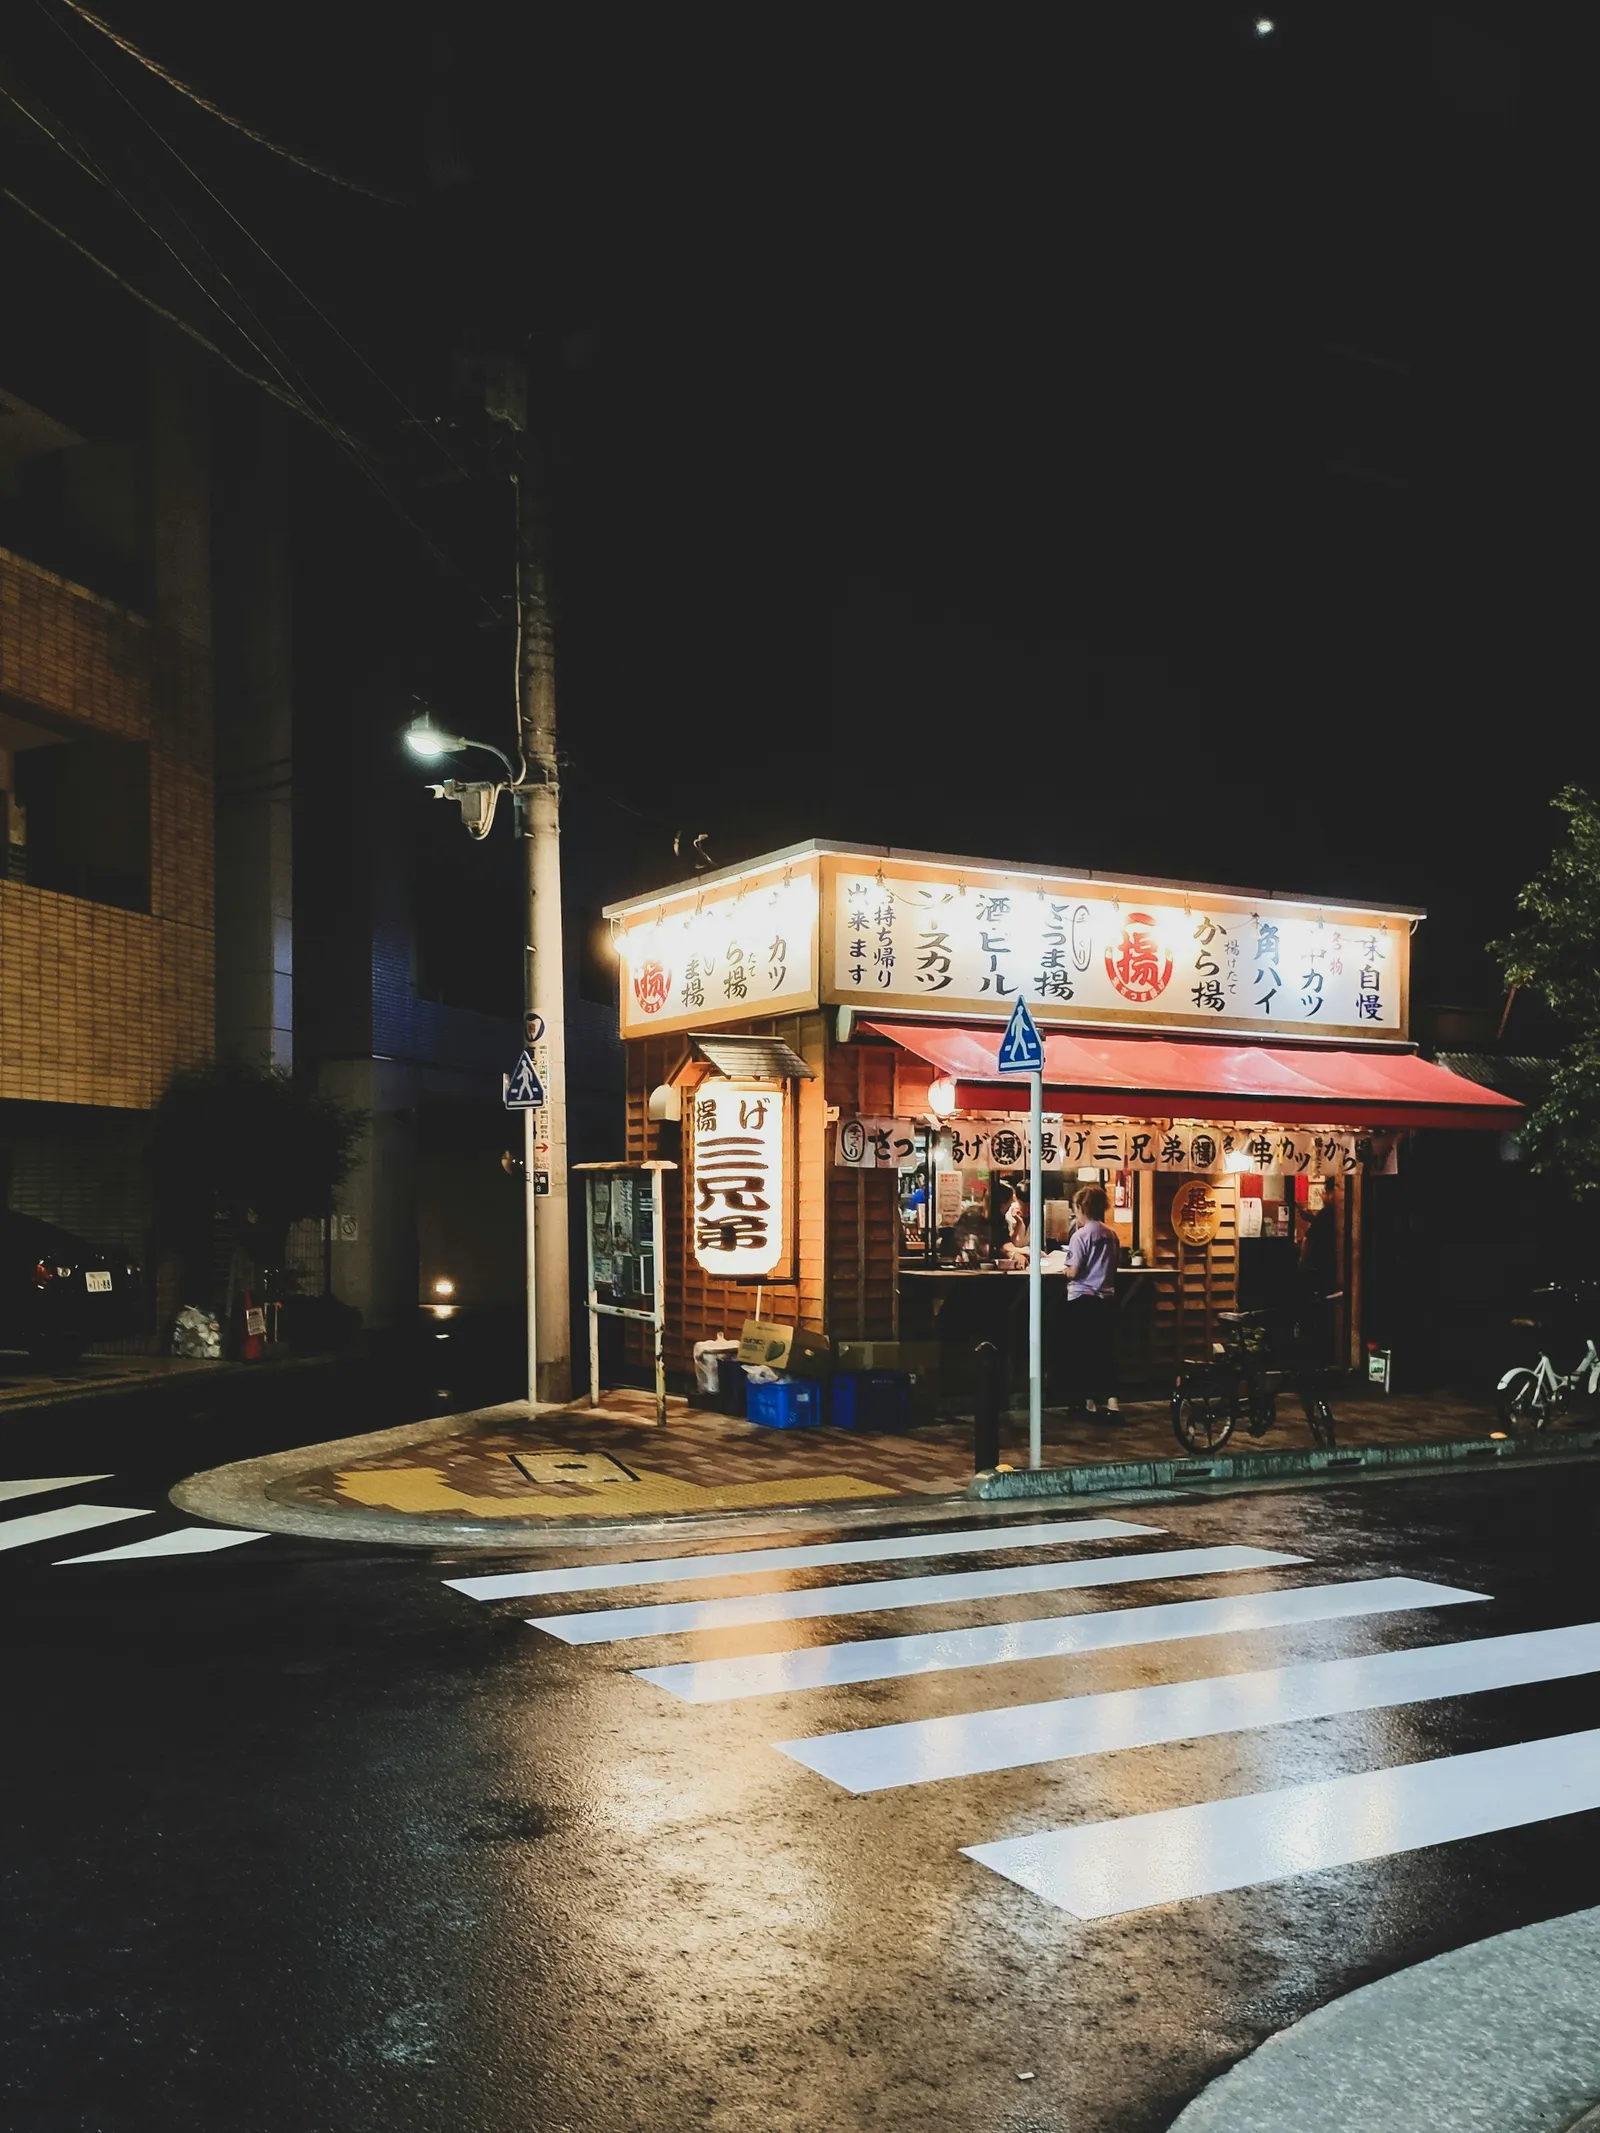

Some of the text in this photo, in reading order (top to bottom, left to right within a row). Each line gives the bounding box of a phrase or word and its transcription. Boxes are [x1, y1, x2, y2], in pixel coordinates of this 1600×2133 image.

[767, 891, 788, 992] カツ
[1190, 915, 1228, 1013] から揚
[1253, 922, 1282, 1016] 角ハイ
[1301, 929, 1328, 1018] カツ
